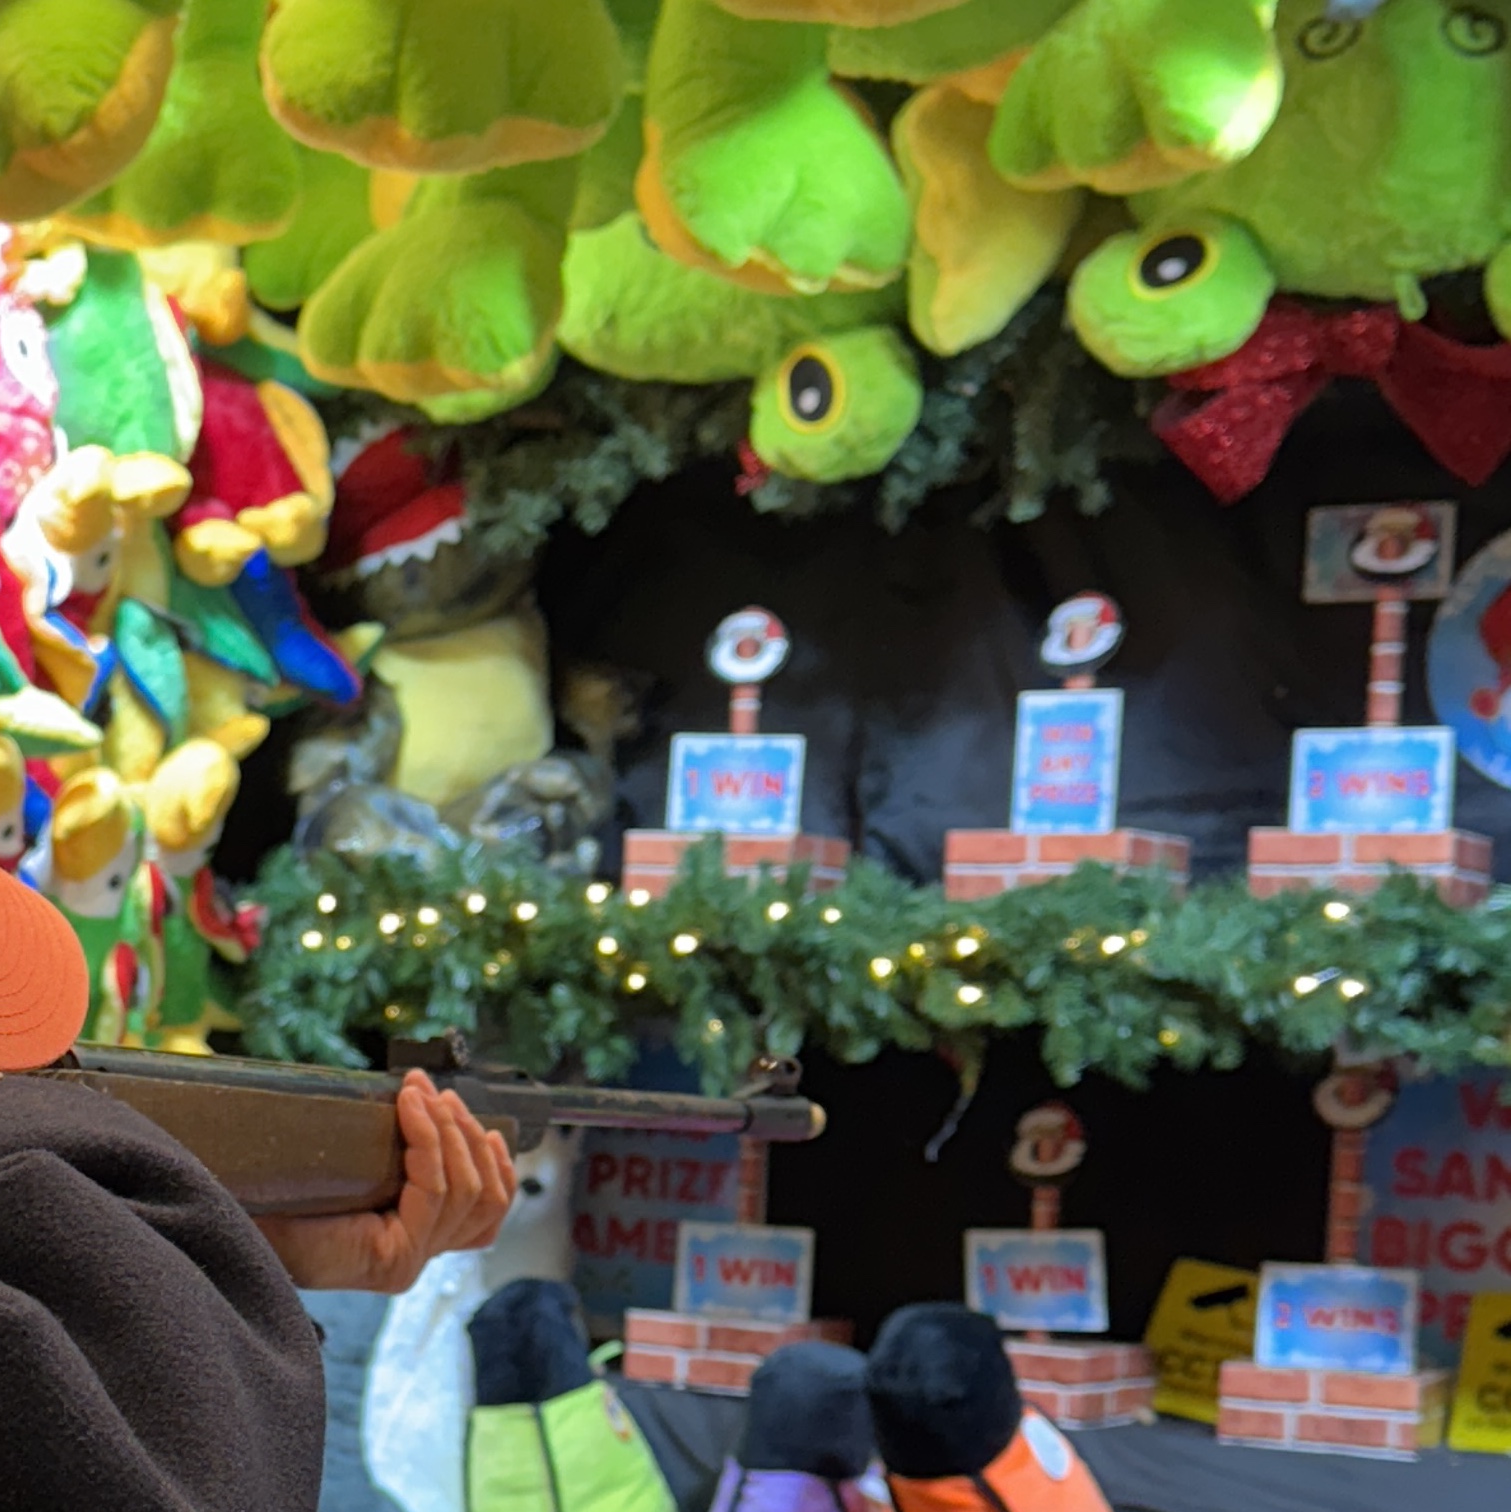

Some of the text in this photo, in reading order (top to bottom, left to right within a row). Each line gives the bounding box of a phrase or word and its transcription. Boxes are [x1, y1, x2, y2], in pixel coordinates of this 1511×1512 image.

[711, 768, 785, 799] WIN
[718, 1257, 797, 1288] WIN
[1006, 1265, 1087, 1295] WIN
